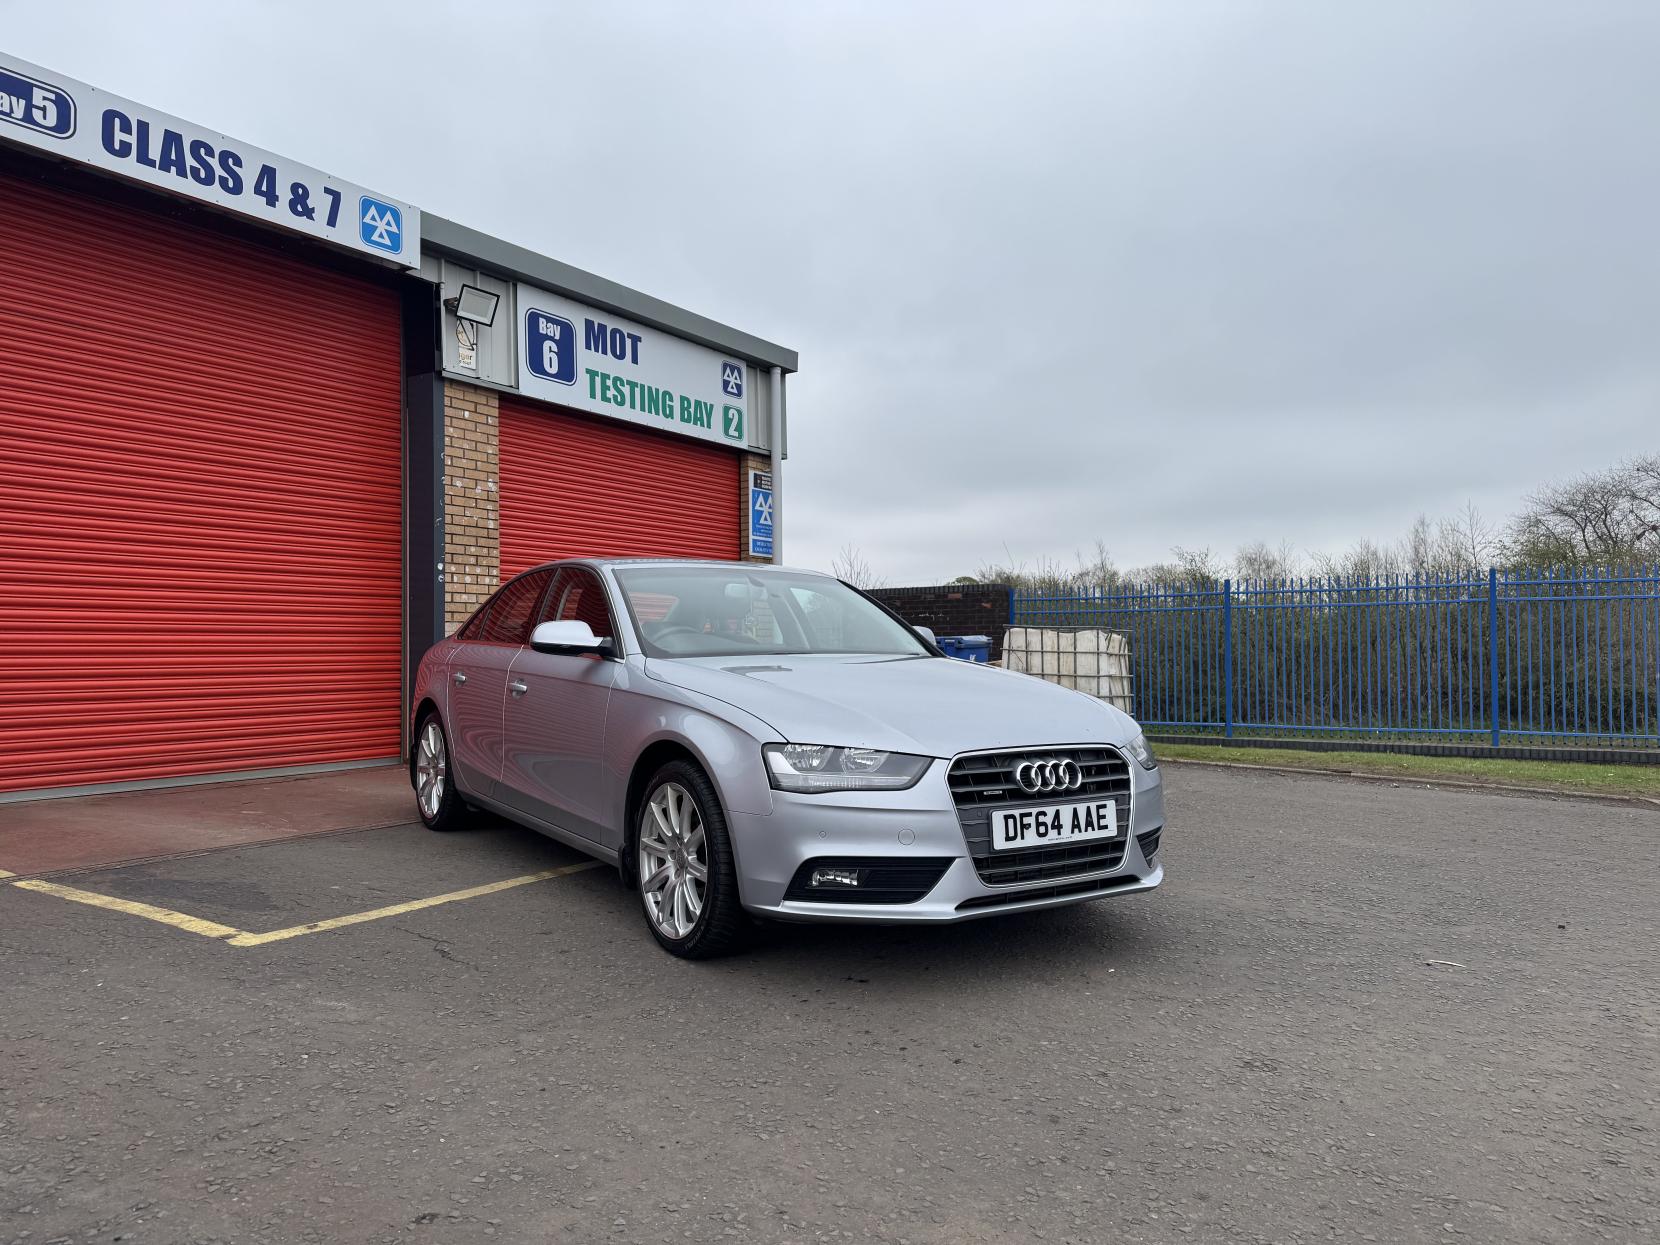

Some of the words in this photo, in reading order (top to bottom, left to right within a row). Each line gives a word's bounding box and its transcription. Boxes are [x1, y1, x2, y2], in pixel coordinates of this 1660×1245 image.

[0, 92, 25, 119] ay
[32, 86, 57, 127] 5
[101, 108, 244, 196] CLASS
[253, 163, 279, 208] 4
[288, 182, 315, 221] &
[323, 186, 342, 228] 7
[538, 316, 561, 340] Bay
[584, 317, 643, 366] MOT
[542, 340, 559, 375] 6
[585, 367, 675, 420] TESTING
[679, 394, 714, 430] BAY
[728, 408, 739, 437] 2
[1003, 809, 1063, 842] DF64
[1070, 804, 1109, 834] AAE
